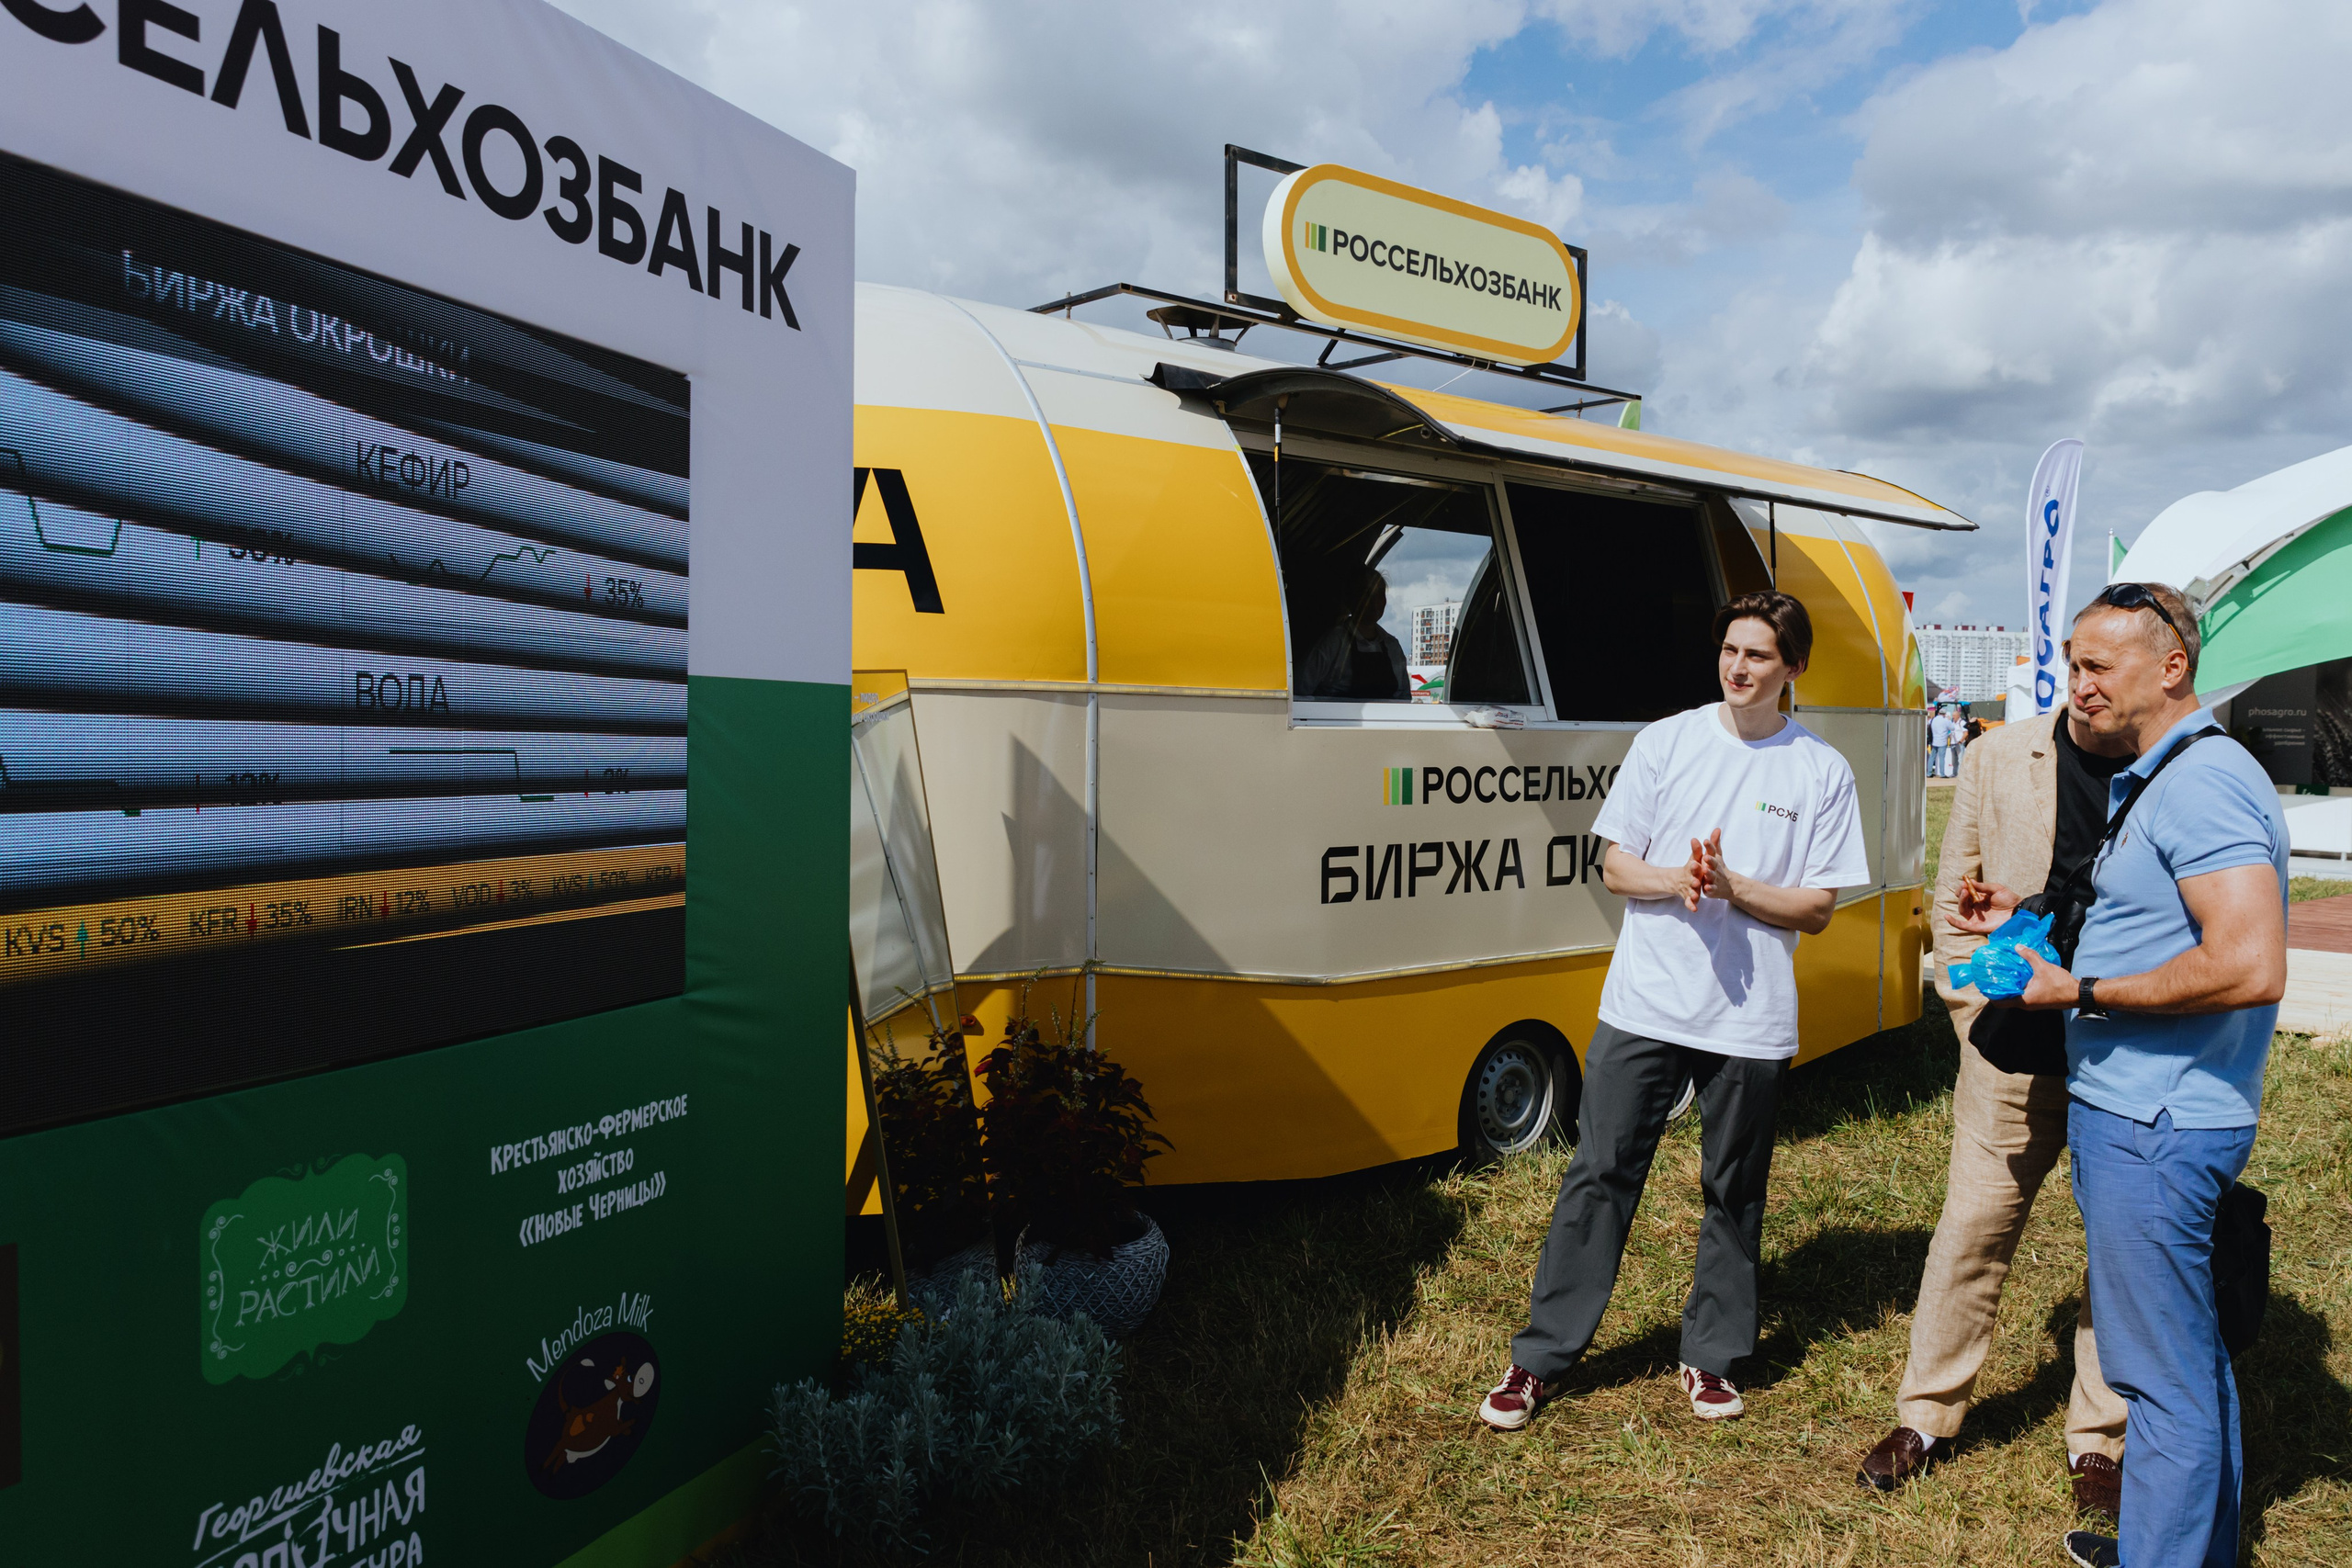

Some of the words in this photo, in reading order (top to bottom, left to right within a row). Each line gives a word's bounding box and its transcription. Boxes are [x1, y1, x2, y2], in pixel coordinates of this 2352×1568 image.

[1331, 228, 1562, 312] РОССЕЛЬХОЗБАНК
[356, 441, 469, 499] КЕФИР
[605, 577, 644, 607] 35%
[2035, 499, 2060, 716] ОСАГРО
[2247, 707, 2308, 717] phosagro.ru
[1767, 805, 1799, 822] РСХБ
[1320, 838, 1525, 905] БИРЖА
[5, 923, 64, 956] KVS
[99, 915, 160, 947] 50%
[188, 907, 239, 937] KFR
[265, 901, 312, 929] 35%
[338, 895, 373, 919] IRN
[396, 889, 430, 913] 12%
[509, 880, 535, 902] 3%
[557, 1147, 634, 1194] ХОЗЯЙСТВО
[256, 1208, 359, 1270] ЖИЛИ
[234, 1246, 381, 1328] РАСТИЛИ
[526, 1305, 613, 1382] Mendoza
[616, 1292, 654, 1333] Milk
[193, 1424, 423, 1551] Георгиевская
